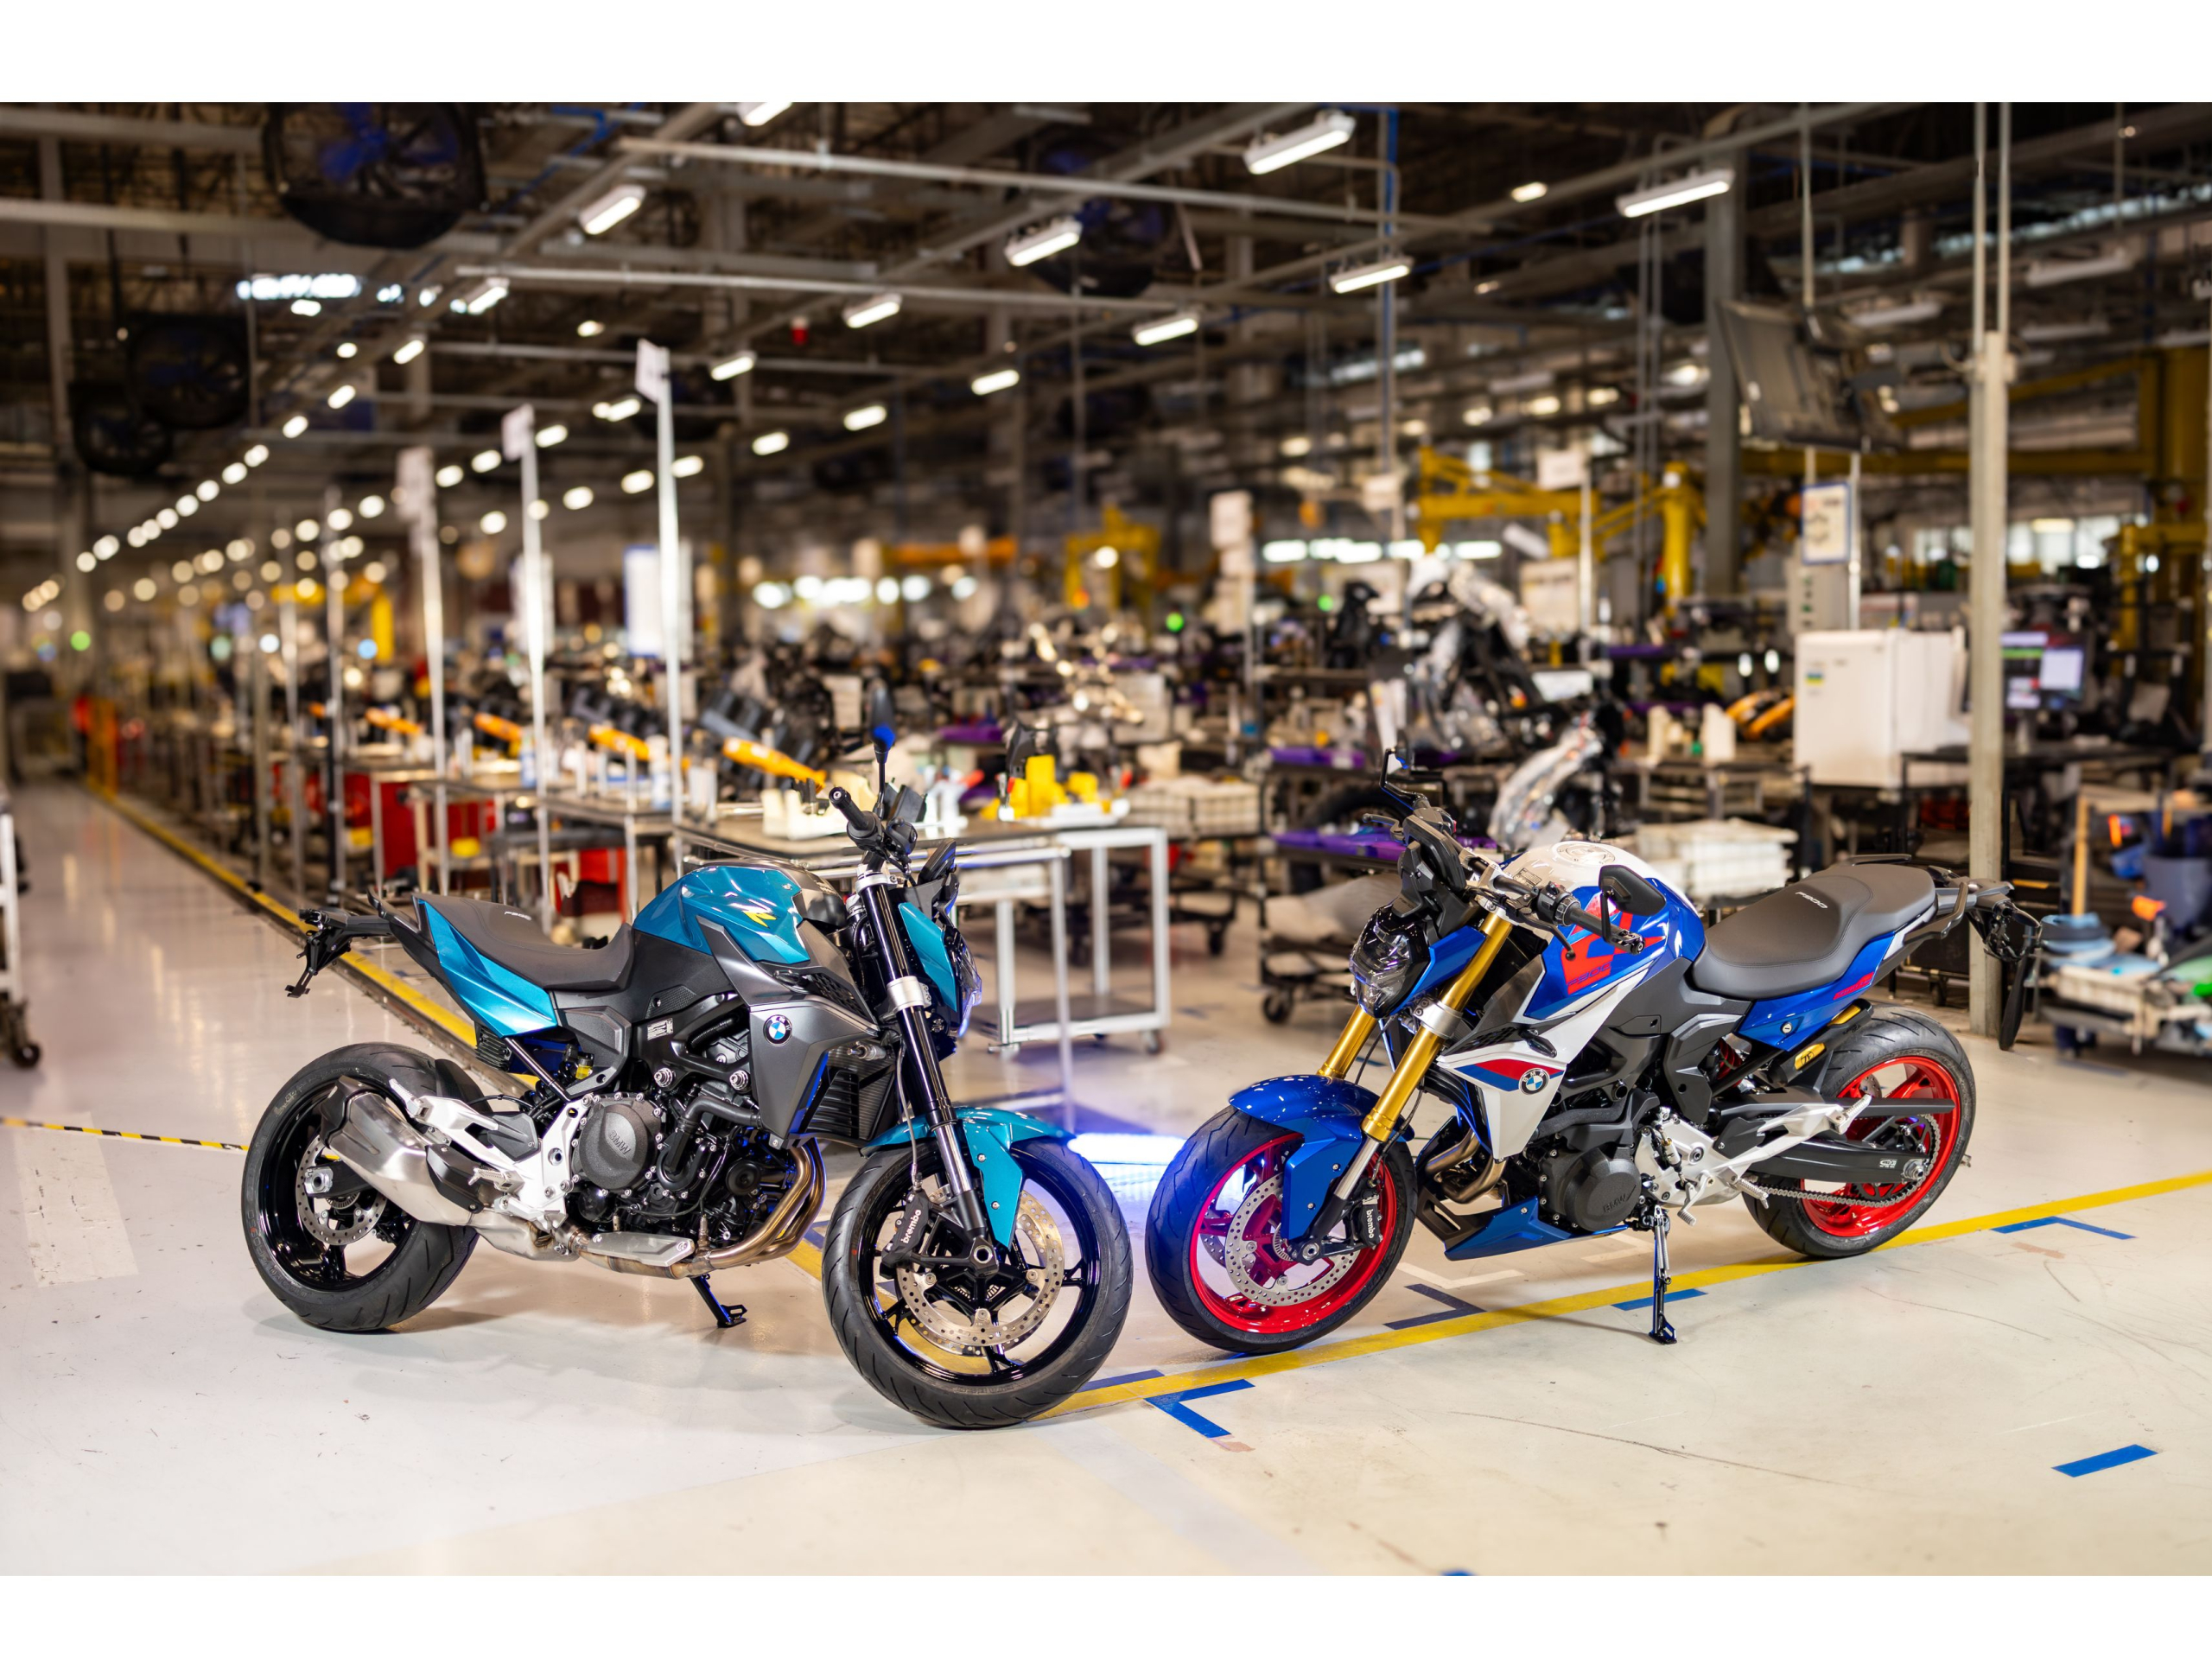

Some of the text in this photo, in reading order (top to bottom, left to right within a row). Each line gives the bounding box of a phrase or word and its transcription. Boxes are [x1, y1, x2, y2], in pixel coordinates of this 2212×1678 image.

[608, 1129, 632, 1155] BMW
[900, 1209, 922, 1244] brembo
[1366, 1209, 1376, 1239] brembo
